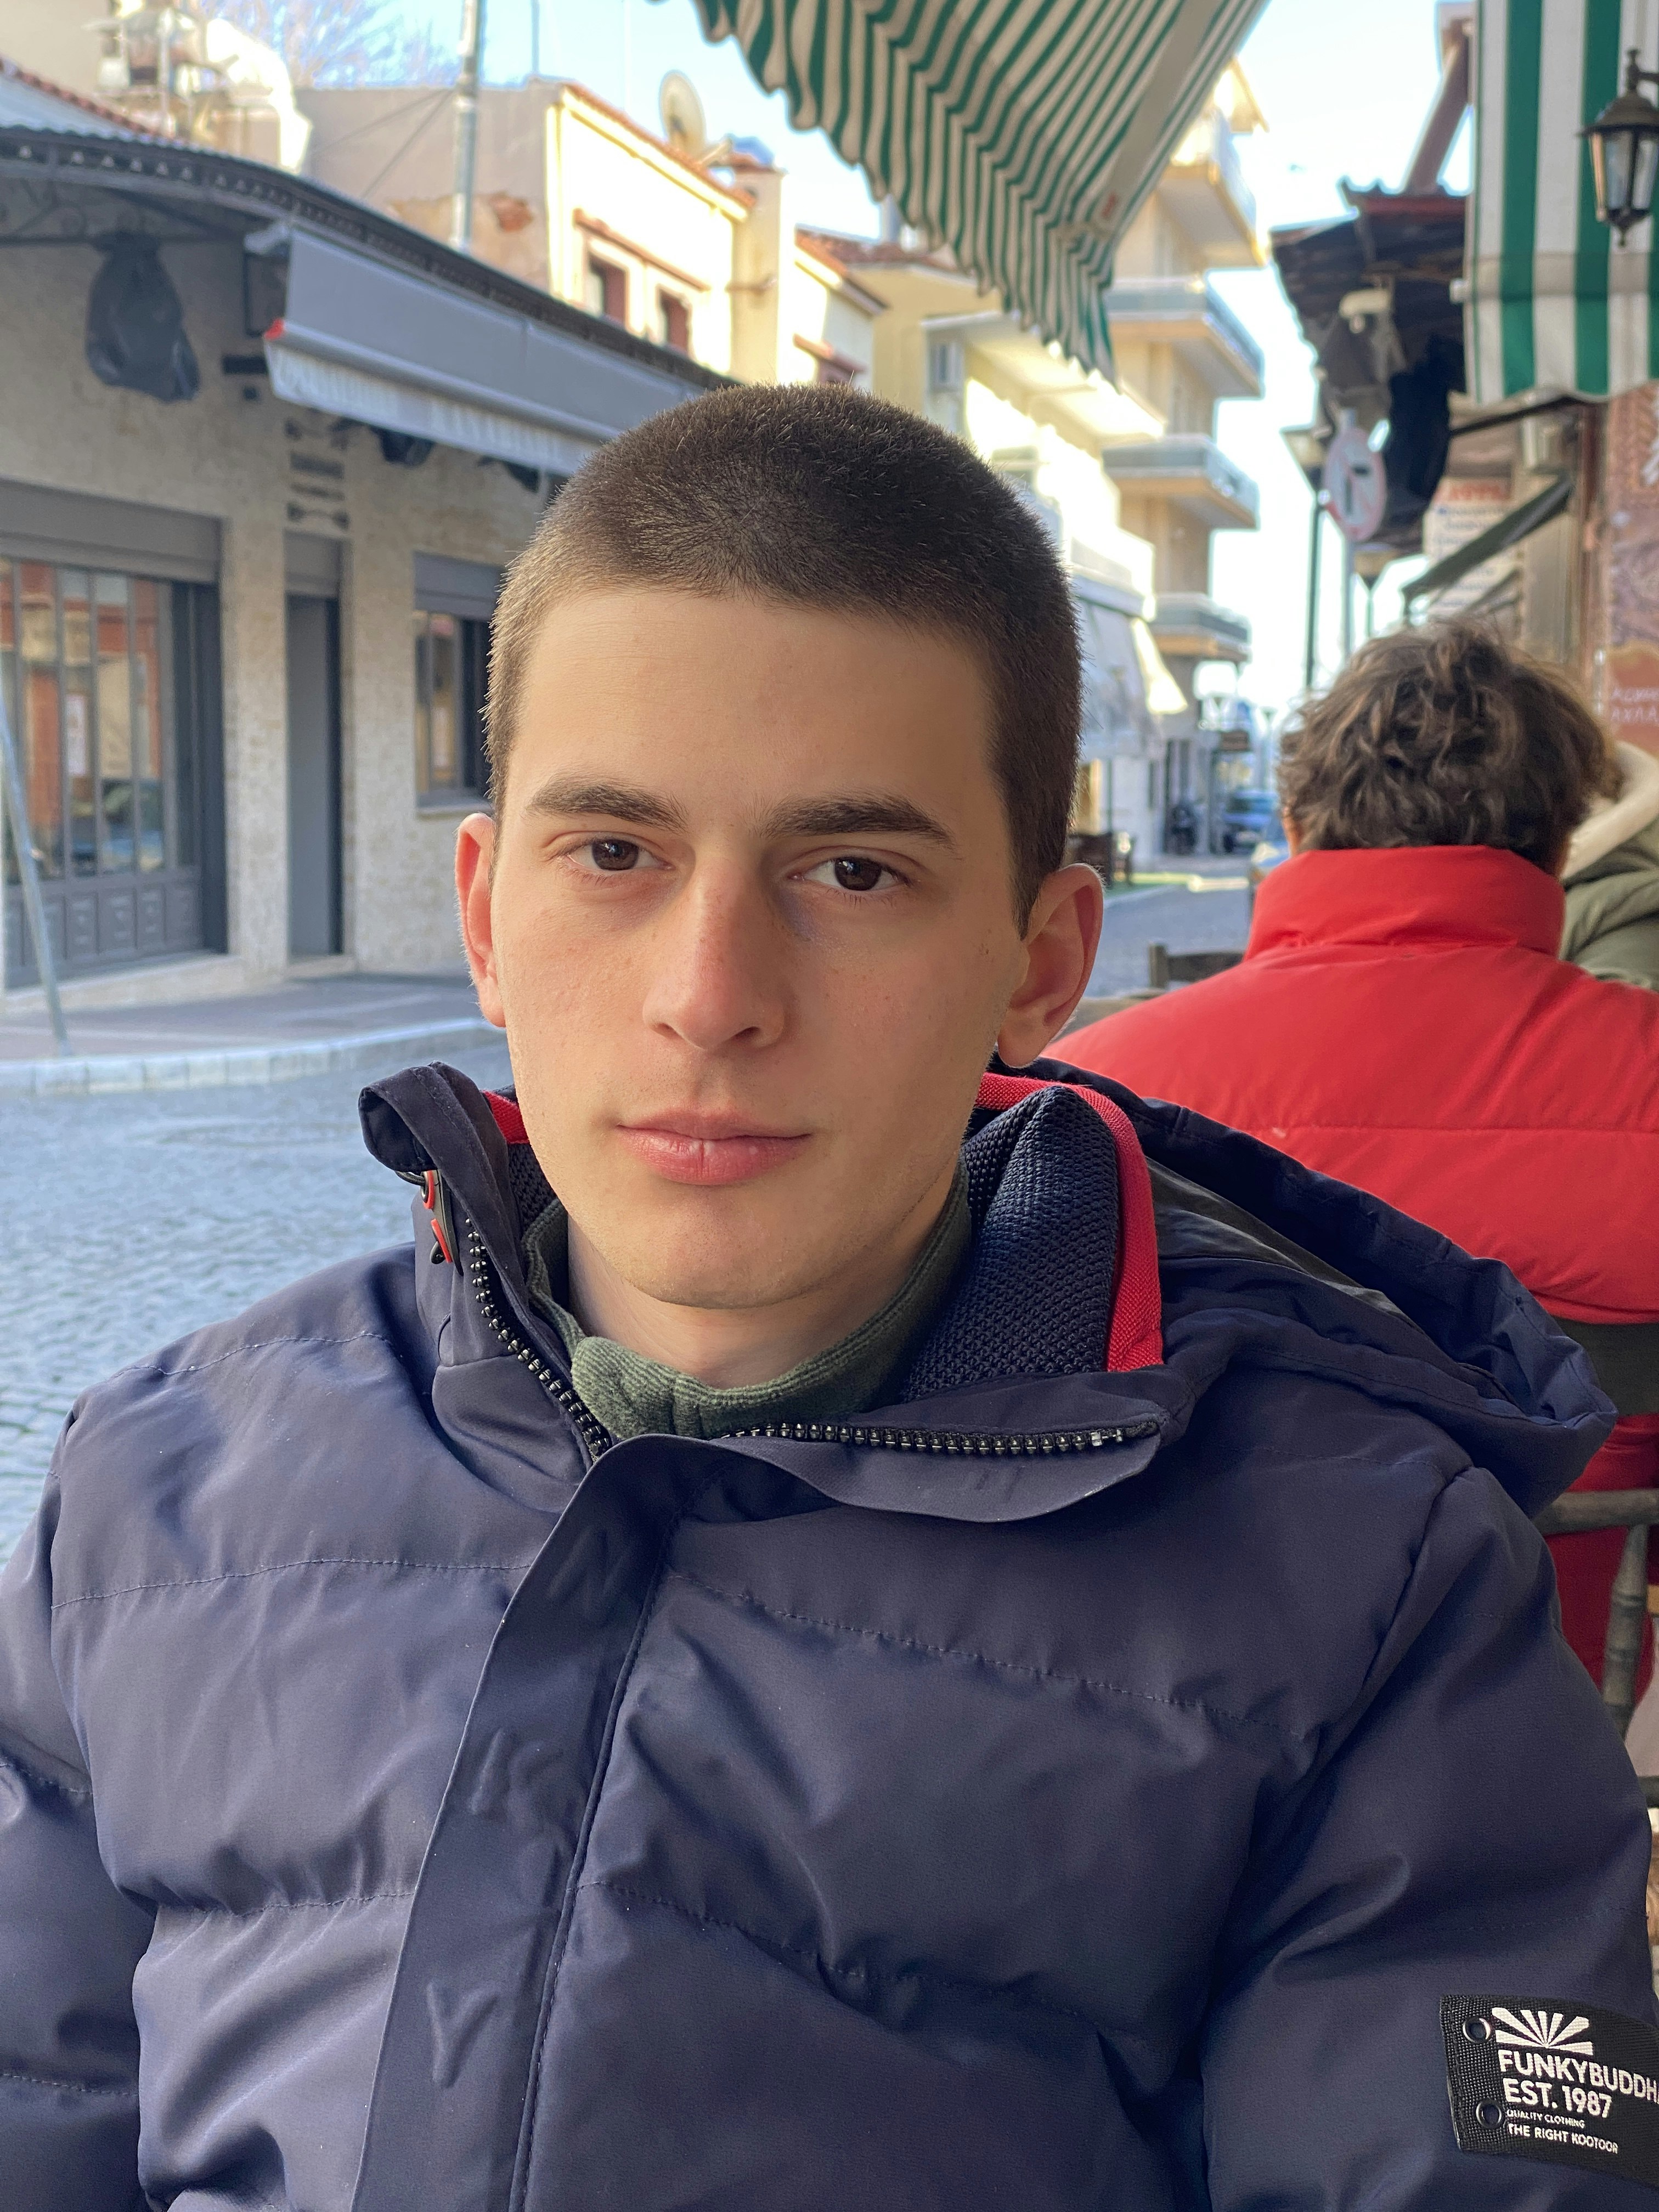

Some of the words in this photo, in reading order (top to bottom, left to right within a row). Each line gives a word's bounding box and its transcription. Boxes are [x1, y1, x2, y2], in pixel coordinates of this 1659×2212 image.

[1498, 2050, 1659, 2104] FUNKYBUDDH
[1503, 2078, 1558, 2108] EST.
[1561, 2085, 1612, 2119] 1987
[1506, 2109, 1543, 2121] QUALITY
[1544, 2114, 1585, 2129] CLOTHING
[1508, 2123, 1531, 2137] THE
[1534, 2127, 1569, 2143] RIGHT
